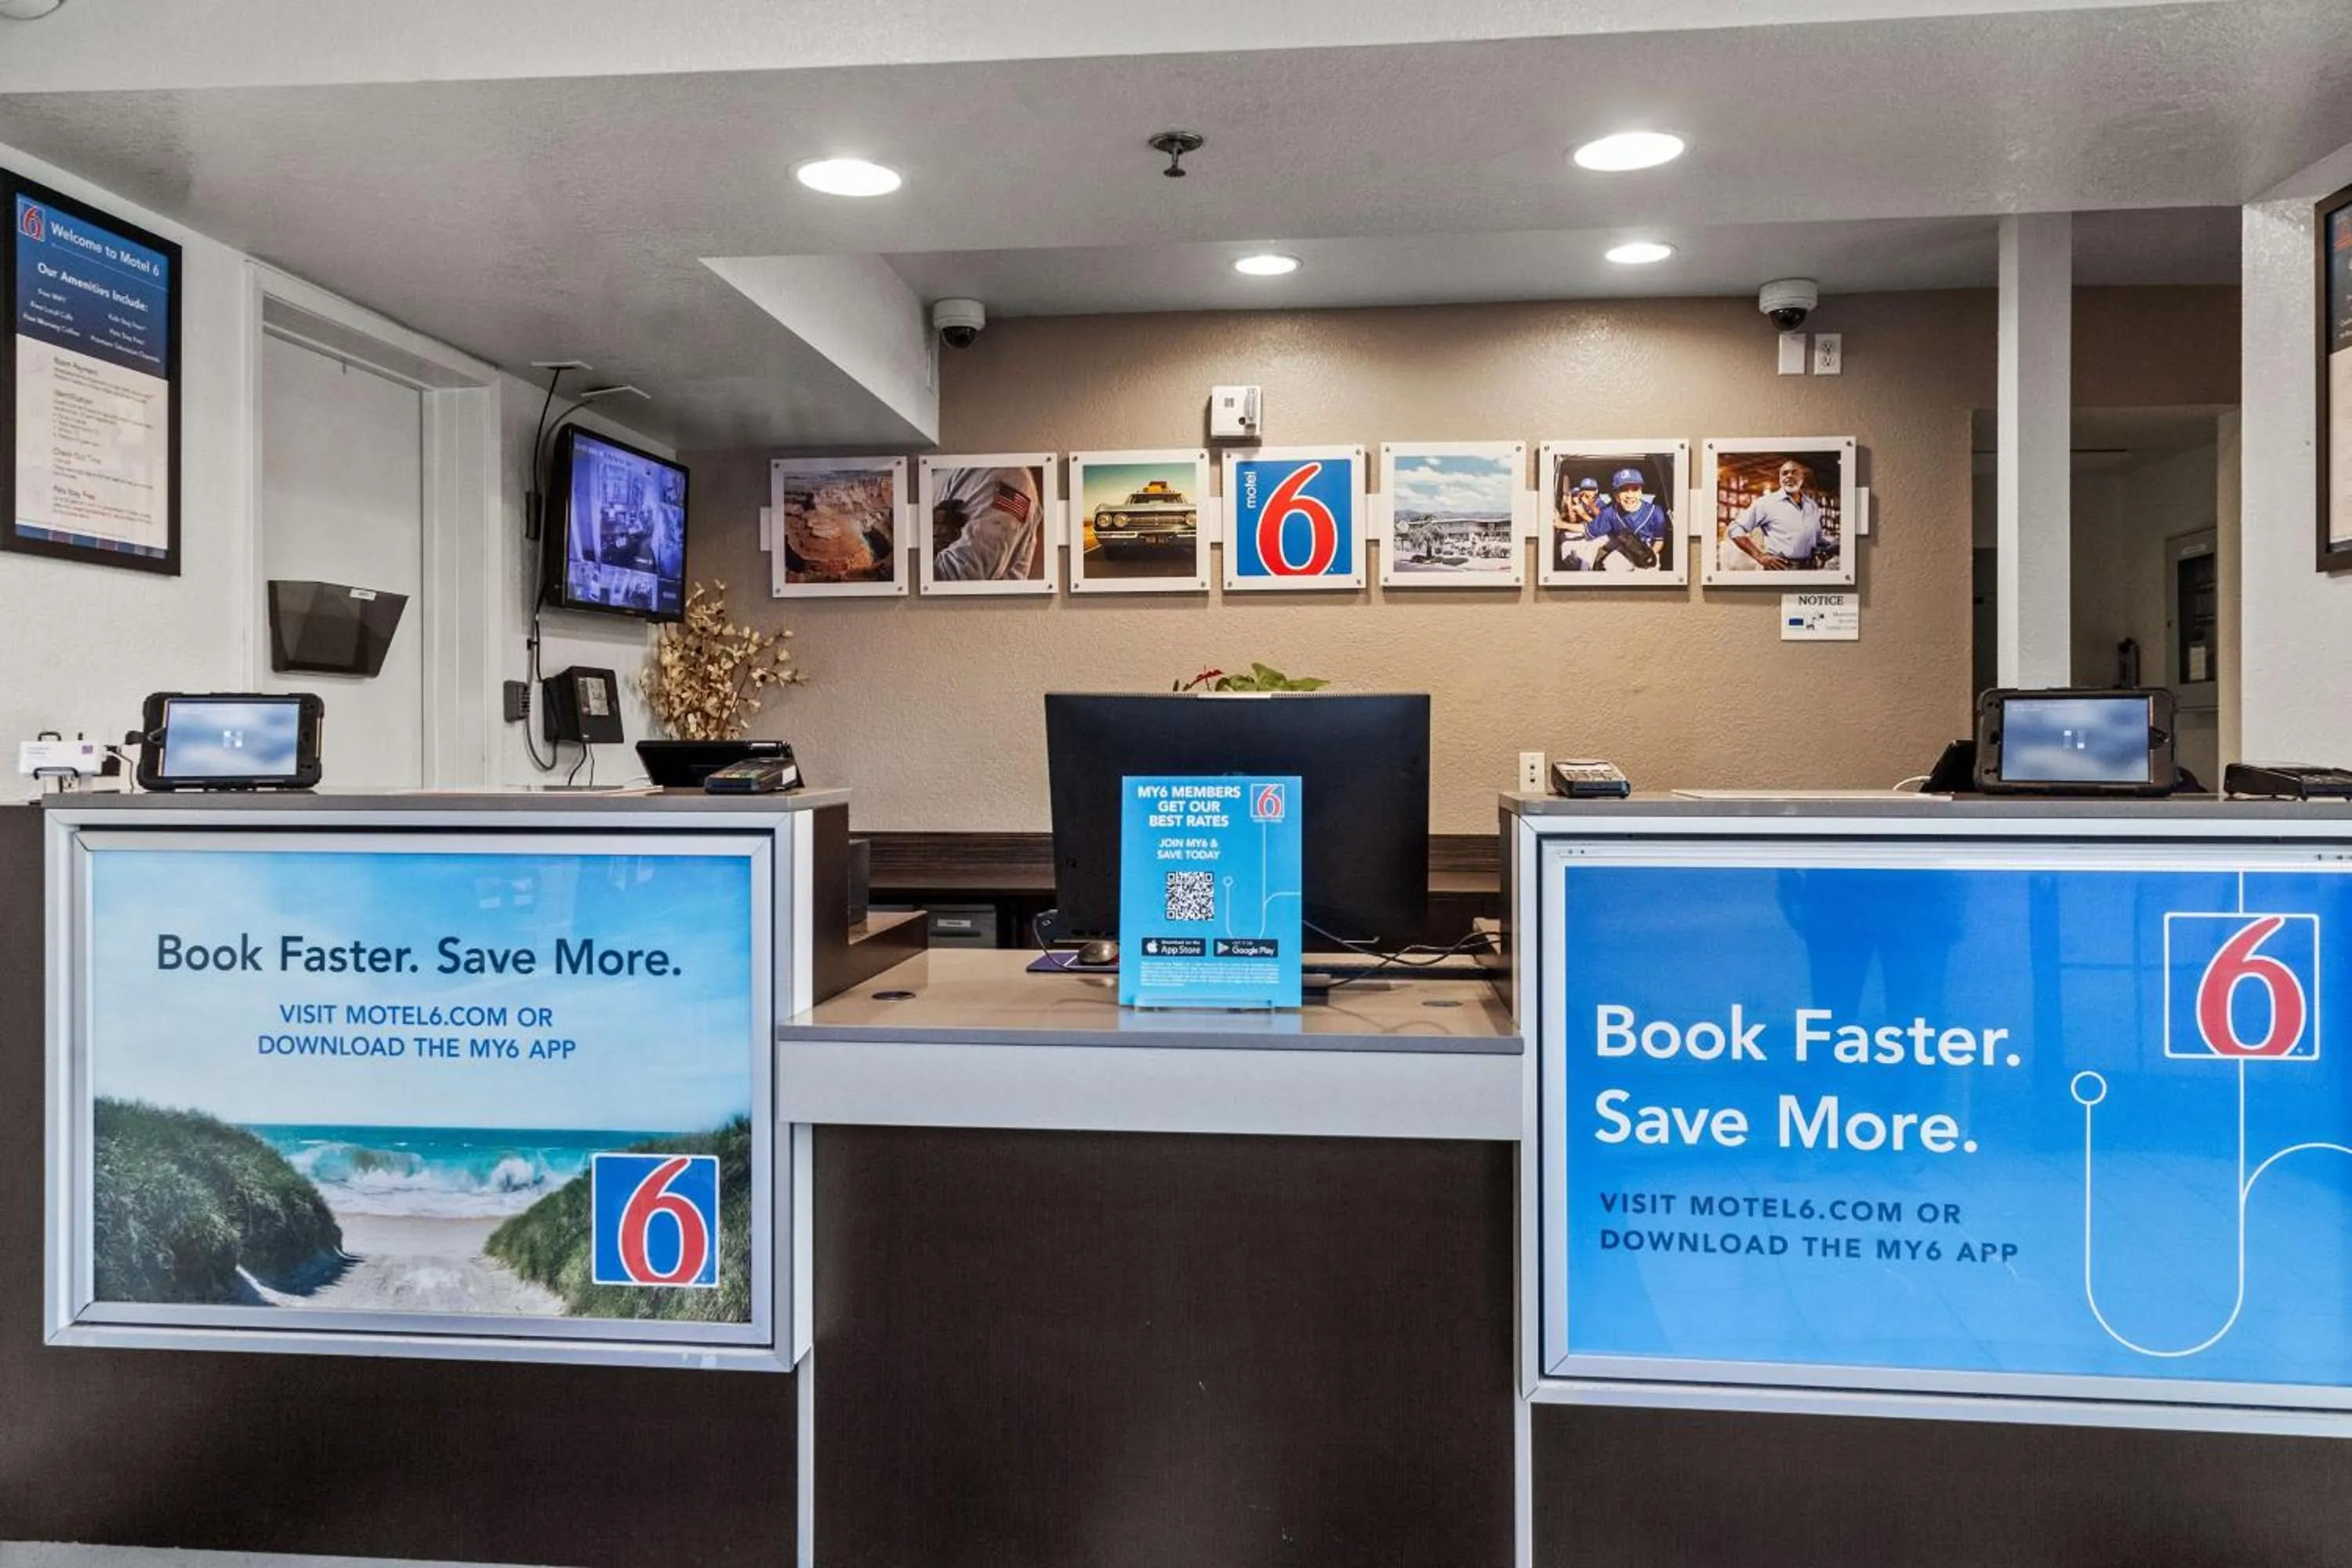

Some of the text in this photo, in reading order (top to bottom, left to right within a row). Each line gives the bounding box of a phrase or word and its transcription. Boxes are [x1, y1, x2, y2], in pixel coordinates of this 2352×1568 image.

[51, 222, 159, 276] Welcome to Motel 6
[38, 263, 149, 312] Our Amenities Include:
[1244, 471, 1257, 509] motel
[1256, 462, 1338, 576] 6
[1798, 596, 1844, 606] NOTICE
[1138, 786, 1241, 798] MY6 MEMBERS
[1158, 800, 1220, 813] GET OUR
[1258, 784, 1281, 818] 6
[1149, 815, 1229, 827] BEST RATES
[1156, 850, 1221, 859] SAVE TODAY
[1159, 838, 1183, 848] JOIN
[1186, 838, 1208, 848] MY6
[157, 933, 682, 976] Book Faster. Save More.
[1161, 946, 1201, 956] App Store
[1232, 946, 1274, 956] Google Play
[2196, 915, 2307, 1057] 6
[280, 1004, 553, 1028] VISIT MOTEL6.COM OR
[258, 1035, 576, 1060] DOWNLOAD THE MY6 APP
[1596, 1004, 2021, 1067] Book Faster.
[1594, 1088, 1978, 1153] Save More.
[618, 1156, 709, 1284] 6
[1600, 1192, 1961, 1224] VISIT MOTEL6.COM OR
[1600, 1229, 2019, 1263] DOWNLOAD THE MY6 APP
